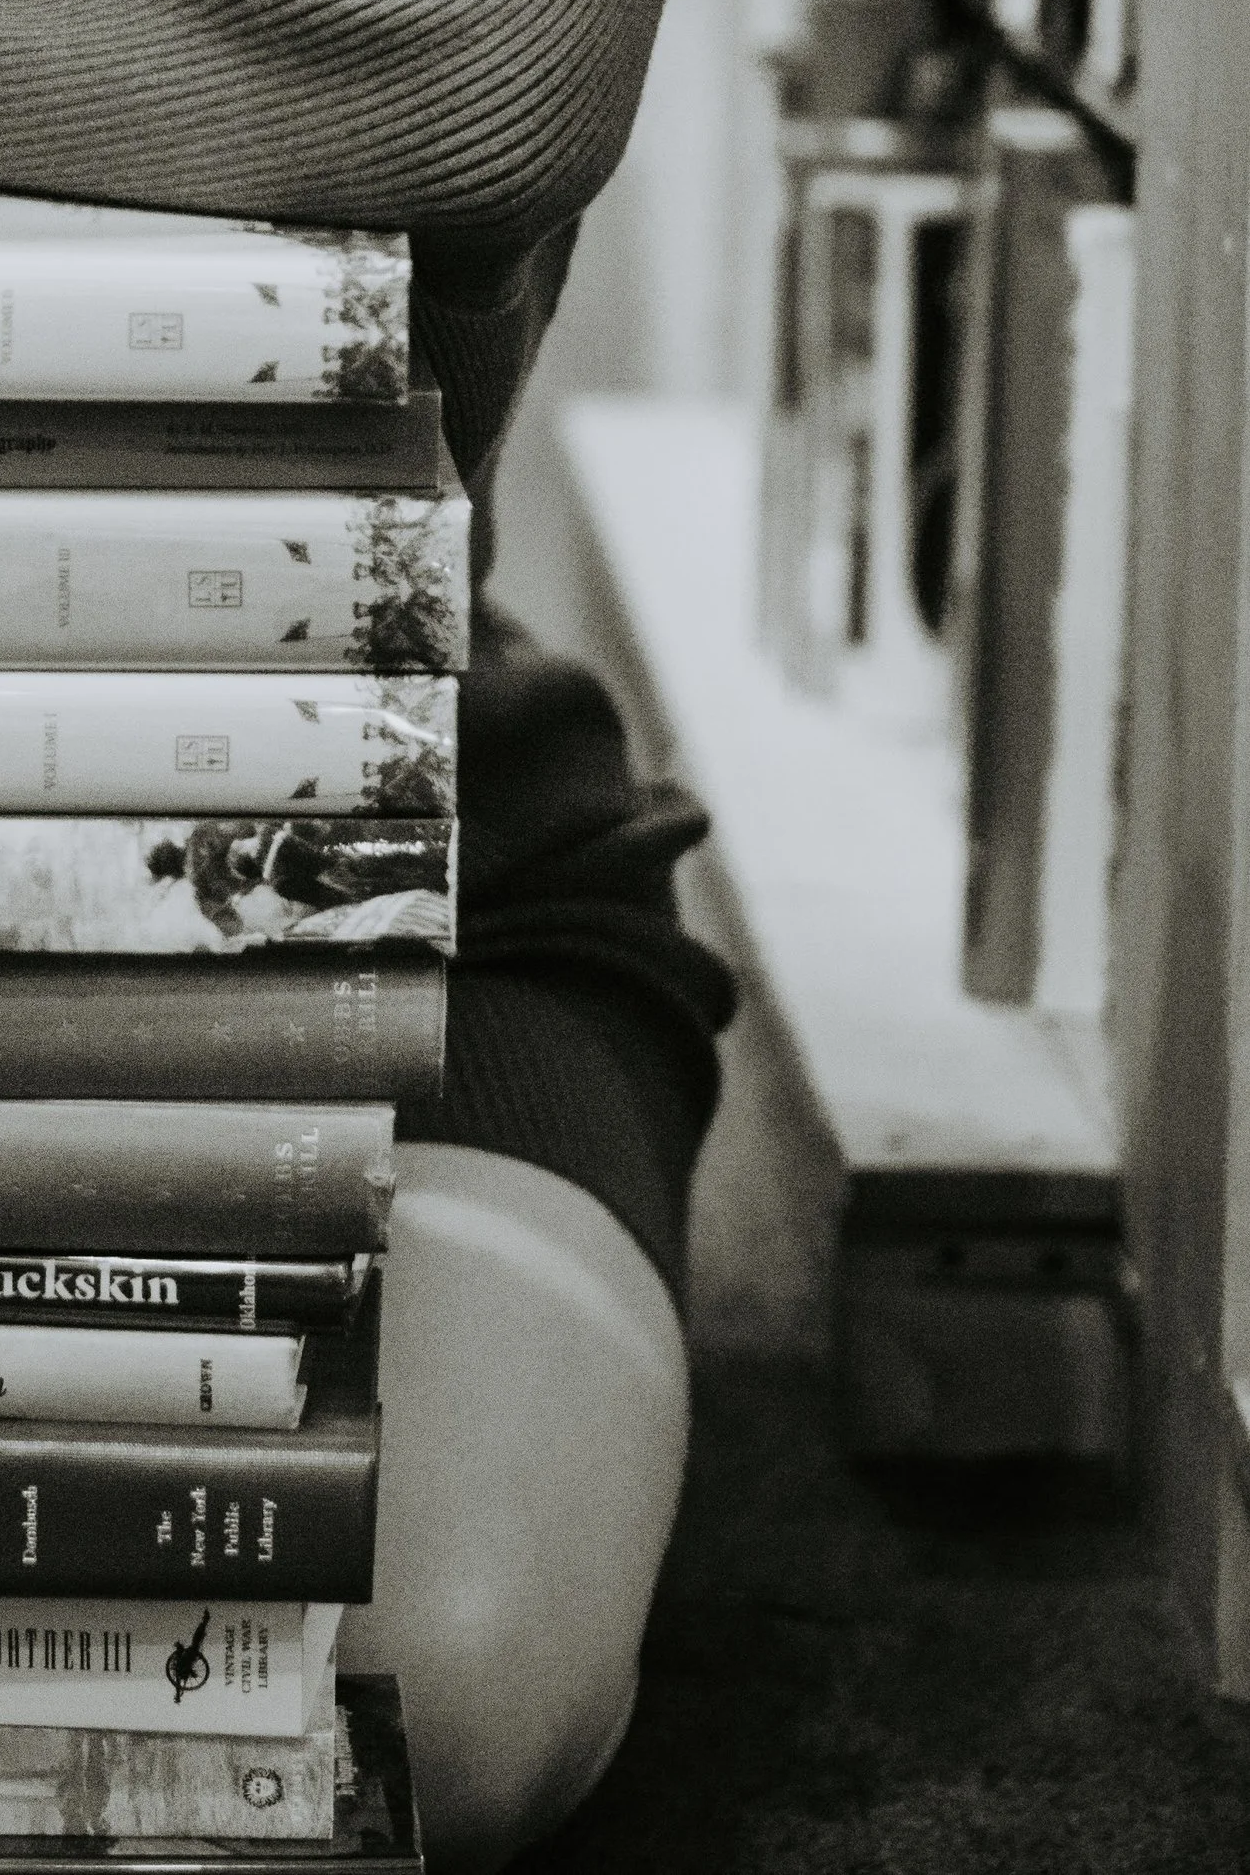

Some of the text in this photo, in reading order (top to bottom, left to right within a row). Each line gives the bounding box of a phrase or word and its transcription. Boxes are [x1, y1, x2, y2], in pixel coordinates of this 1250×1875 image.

[57, 566, 71, 629] VOLUME
[239, 1263, 256, 1330] Oklaho
[199, 1359, 213, 1413] CROWN
[21, 1485, 38, 1565] Dornbusch
[156, 1510, 172, 1544] The
[190, 1486, 206, 1566] New York
[223, 1501, 240, 1556] Public
[257, 1497, 278, 1562] Library
[103, 1631, 133, 1673] III
[225, 1625, 235, 1687] VINTAGE
[241, 1618, 251, 1694] CIVIL WAR
[258, 1627, 269, 1689] LIBRARY
